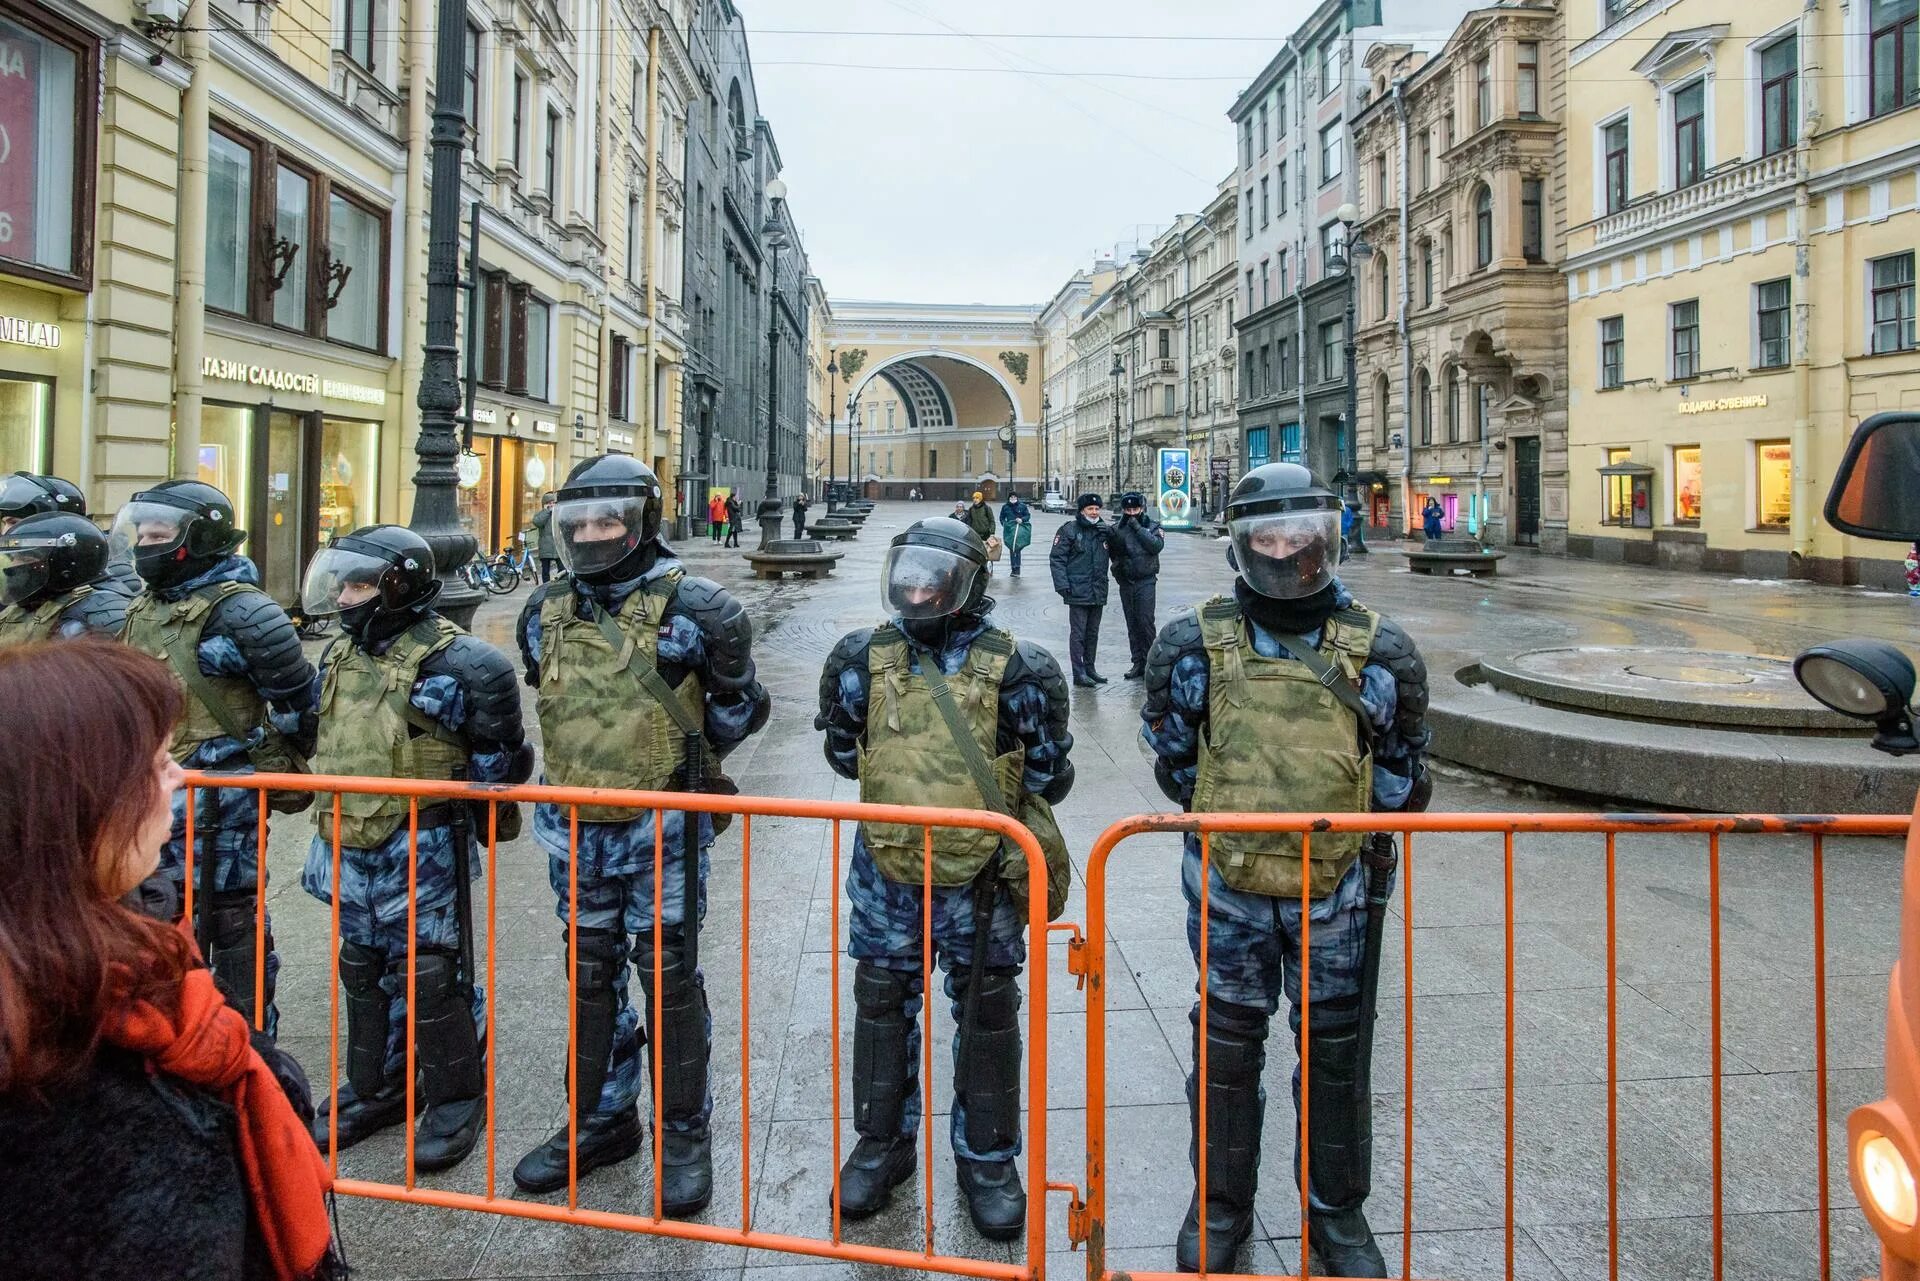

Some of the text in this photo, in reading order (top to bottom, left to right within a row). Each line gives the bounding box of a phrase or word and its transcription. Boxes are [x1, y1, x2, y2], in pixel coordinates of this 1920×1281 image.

[201, 357, 247, 382] ГАЗИН
[248, 365, 320, 395] СЛАДОСТЕЙ
[1679, 394, 1768, 415] ПОДАРКИ-СУВЕНИРЫ
